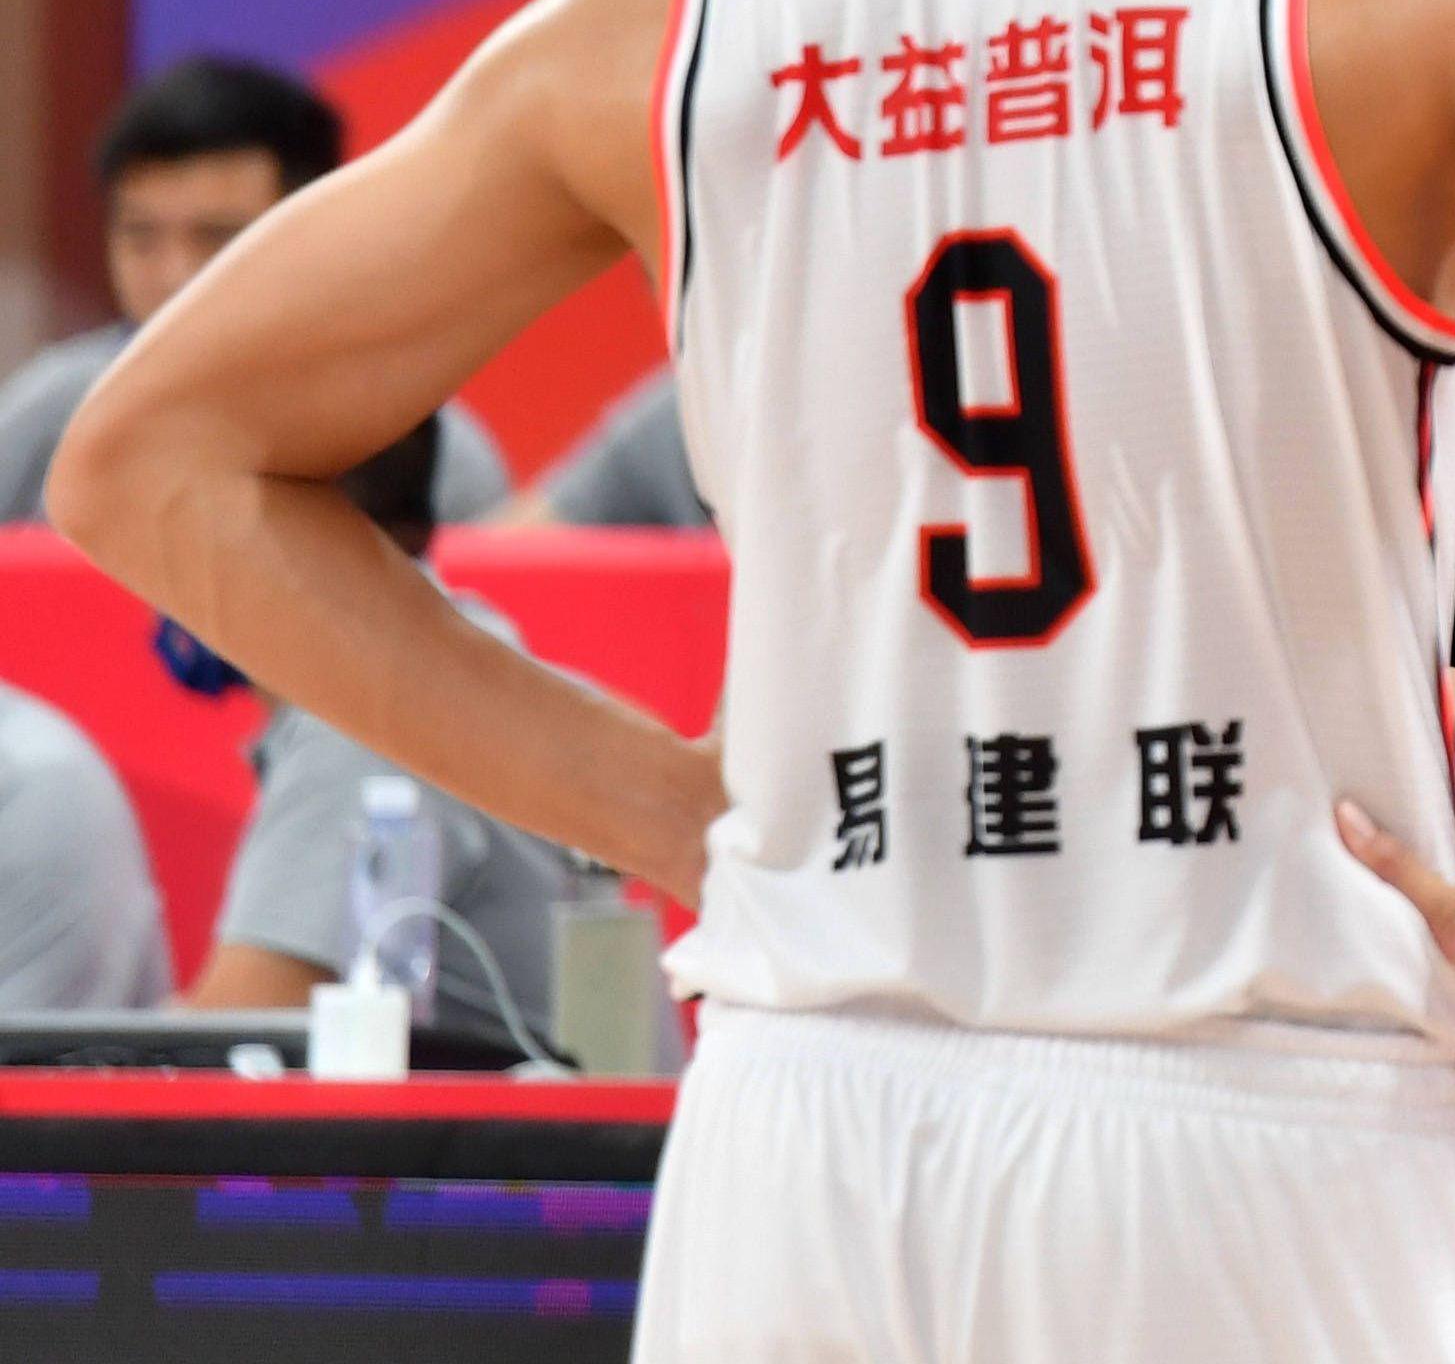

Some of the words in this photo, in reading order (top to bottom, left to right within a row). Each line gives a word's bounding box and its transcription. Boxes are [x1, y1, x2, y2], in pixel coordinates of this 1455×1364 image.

[770, 6, 1190, 163] 大益普洱
[903, 226, 1097, 650] 9
[831, 719, 1244, 872] 易建联
